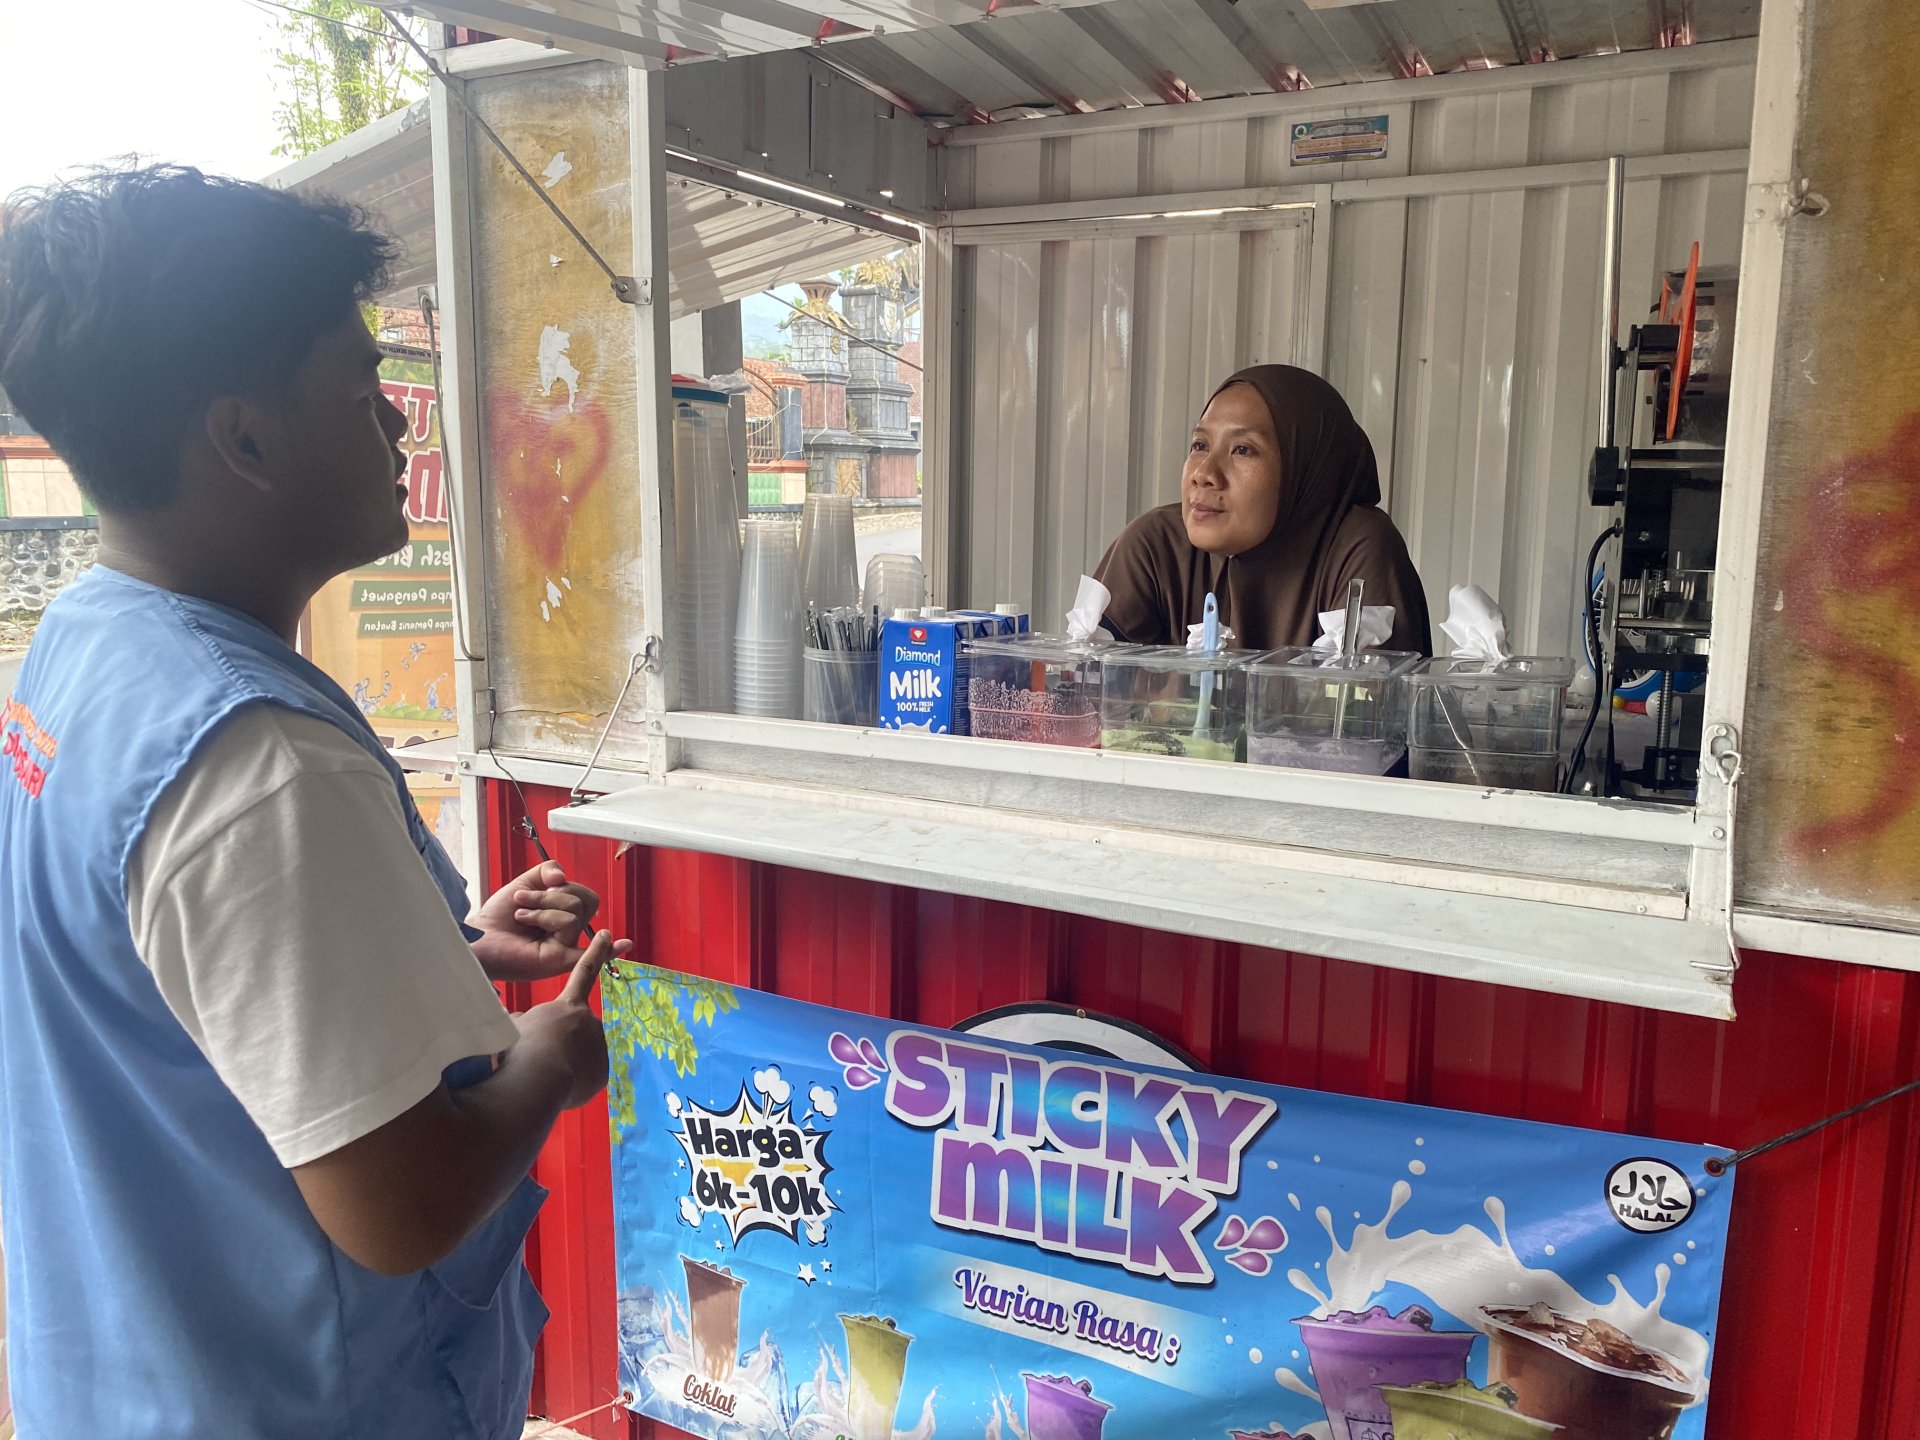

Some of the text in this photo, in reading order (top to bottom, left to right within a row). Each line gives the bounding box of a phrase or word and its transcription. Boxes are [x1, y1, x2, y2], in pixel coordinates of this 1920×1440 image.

[895, 646, 941, 667] Diamond
[890, 668, 942, 700] Milk
[896, 701, 919, 712] 100%
[889, 1032, 1270, 1188] STICKY
[684, 1117, 804, 1168] Harga
[696, 1168, 826, 1216] 6k-10k
[936, 1136, 1209, 1277] MILK
[1619, 1203, 1676, 1222] HALAL
[955, 1268, 1066, 1329] Varian
[1073, 1300, 1161, 1356] Rasa
[683, 1373, 736, 1416] Coklat
